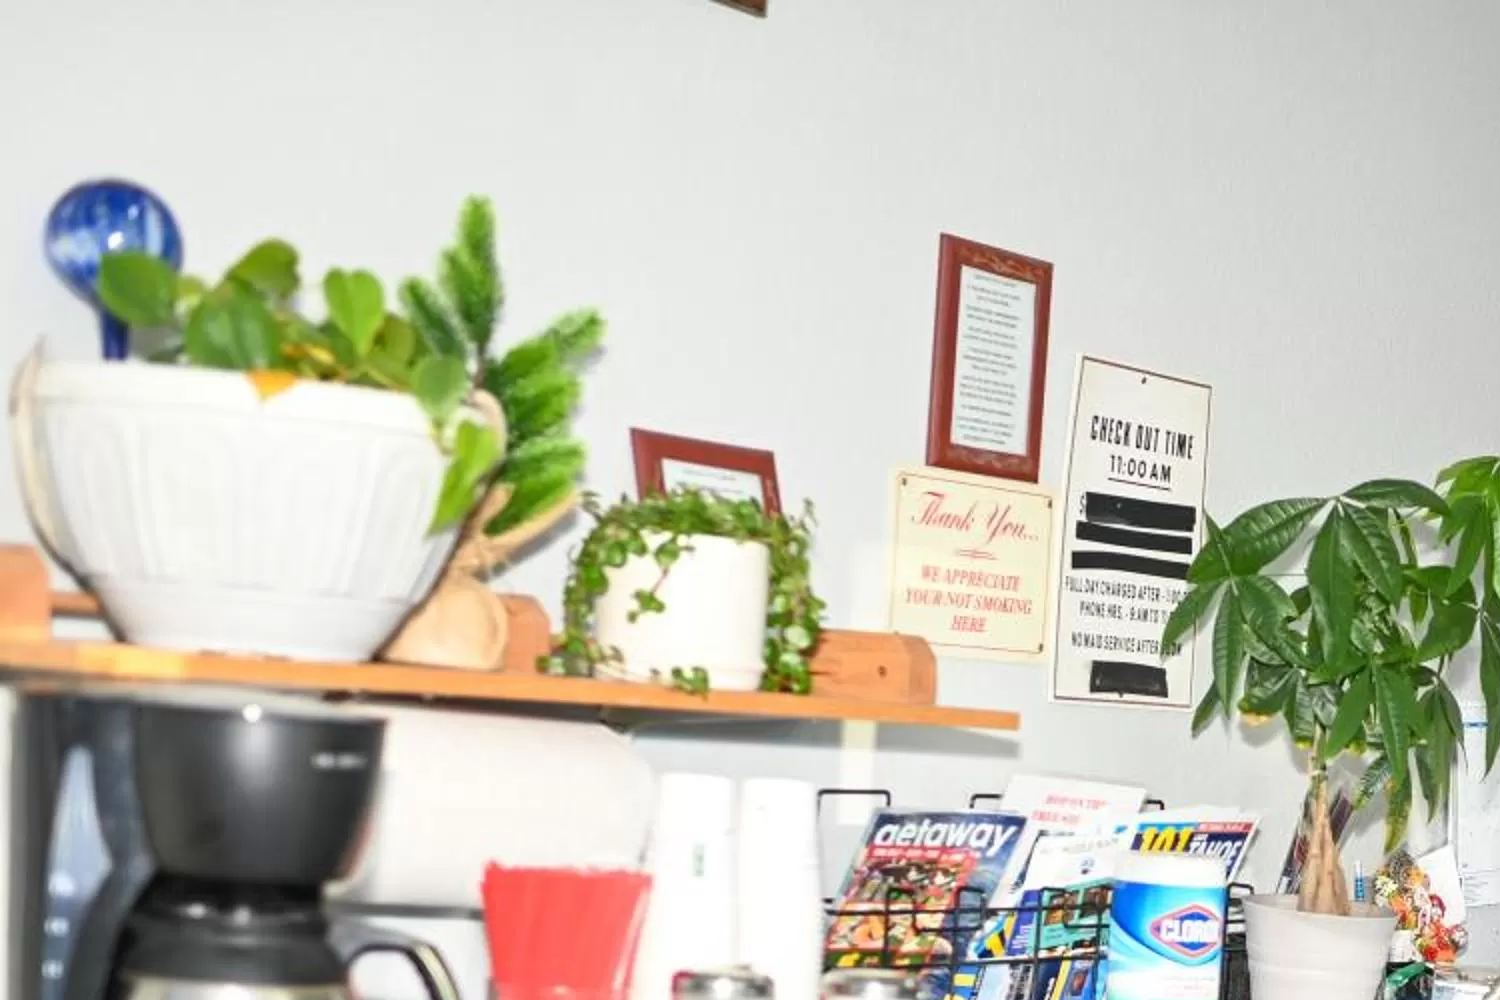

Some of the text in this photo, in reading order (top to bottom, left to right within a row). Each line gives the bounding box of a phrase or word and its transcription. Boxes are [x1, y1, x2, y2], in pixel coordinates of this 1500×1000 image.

[1090, 415, 1194, 459] CHECK OUT TIME
[1109, 454, 1171, 483] 11:00 AM
[911, 491, 975, 532] Thank
[921, 565, 1020, 592] WE APPRECIATE
[1085, 578, 1099, 595] DAY
[1101, 580, 1136, 599] CHARGED
[1138, 586, 1160, 602] AFTER
[906, 587, 1032, 615] YOUR NOT SMOKING
[1080, 600, 1105, 618] PHONE
[950, 615, 987, 632] HERE
[1071, 631, 1082, 648] NO
[1084, 633, 1102, 649] MAID
[1104, 635, 1135, 653] SERVICE
[1137, 639, 1159, 655] AFTER
[873, 819, 1018, 858] getaway
